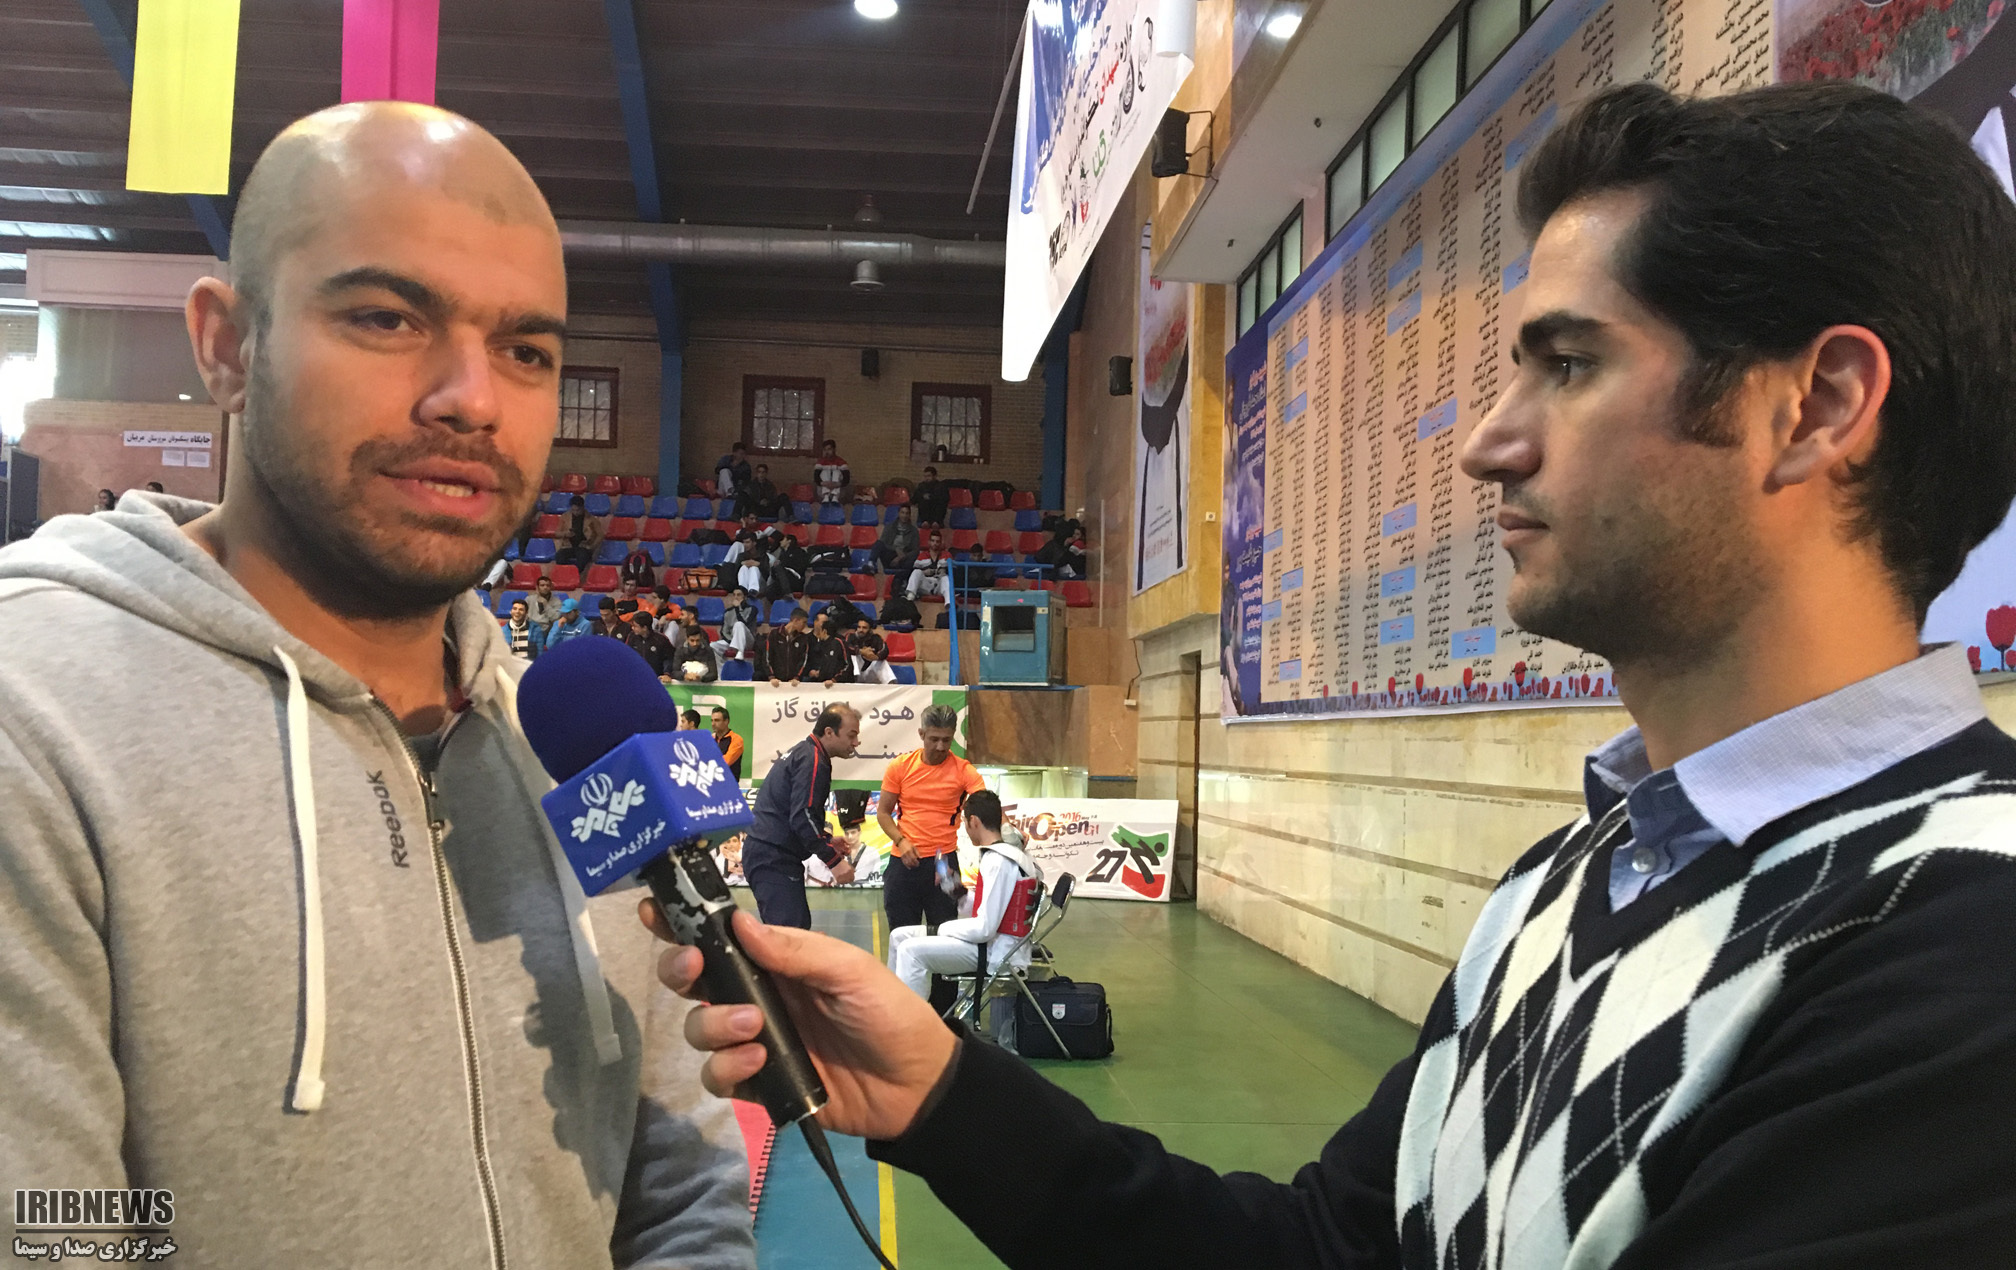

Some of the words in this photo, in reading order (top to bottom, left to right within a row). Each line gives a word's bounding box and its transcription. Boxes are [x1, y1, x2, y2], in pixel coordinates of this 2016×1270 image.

[771, 697, 800, 723] گاز
[869, 705, 915, 726] هود
[1029, 812, 1090, 842] Open
[1085, 848, 1128, 883] 27
